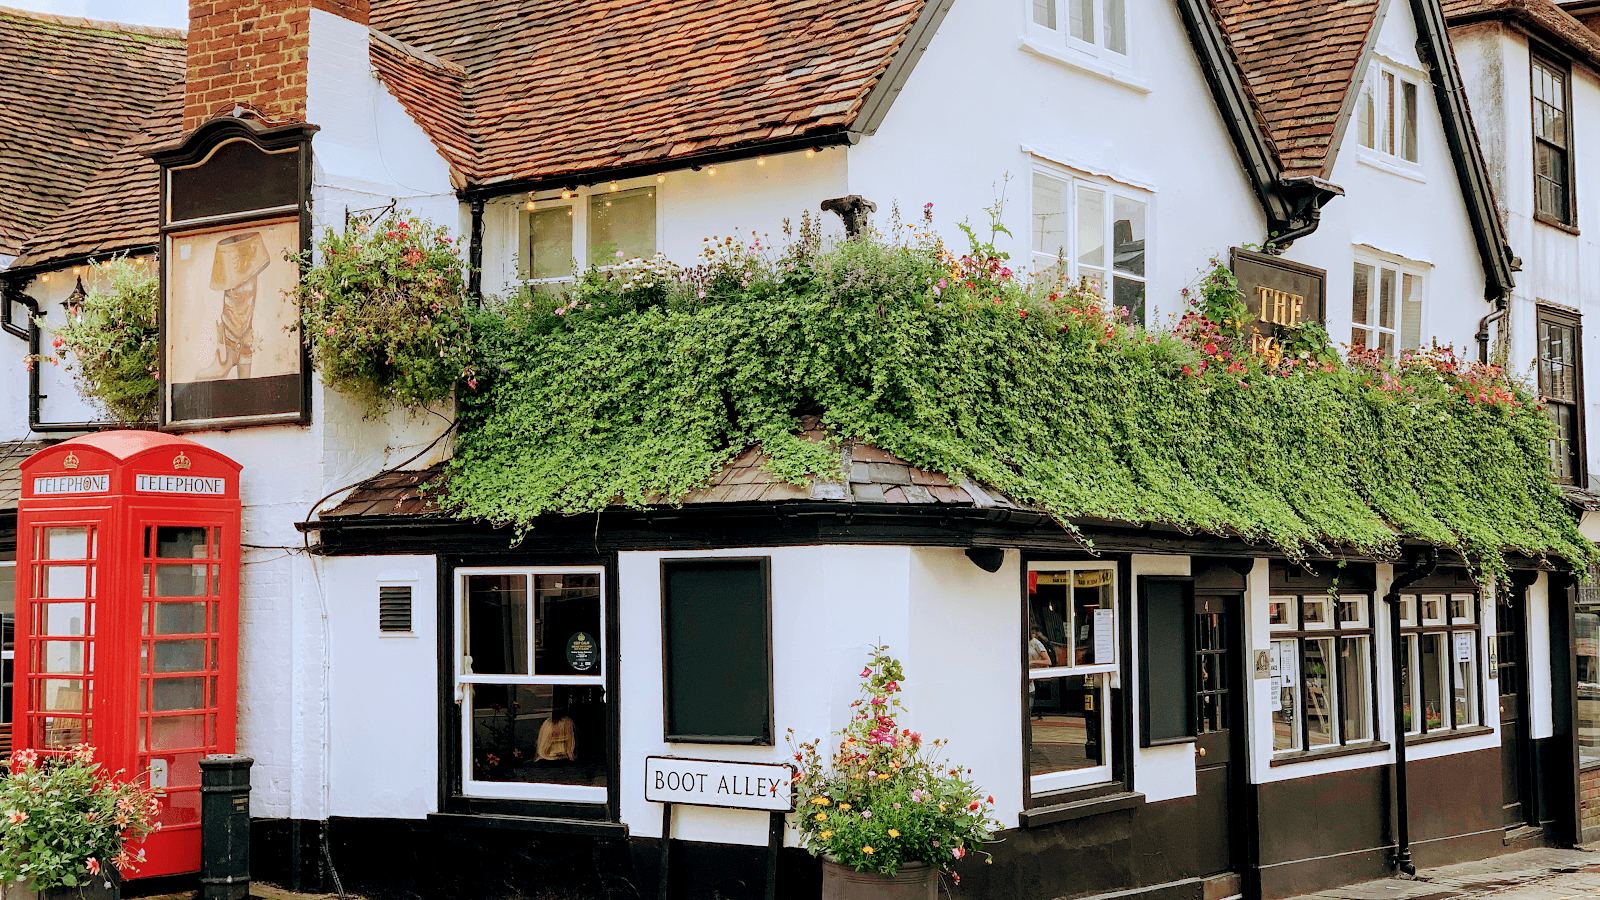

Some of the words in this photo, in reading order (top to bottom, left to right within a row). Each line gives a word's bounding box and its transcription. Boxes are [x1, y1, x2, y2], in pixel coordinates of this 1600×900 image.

[1253, 284, 1303, 328] THE
[37, 474, 107, 493] TELEPHONE
[138, 475, 222, 494] TELEPHONE
[654, 770, 709, 793] BOOT
[717, 775, 781, 798] ALLEY
